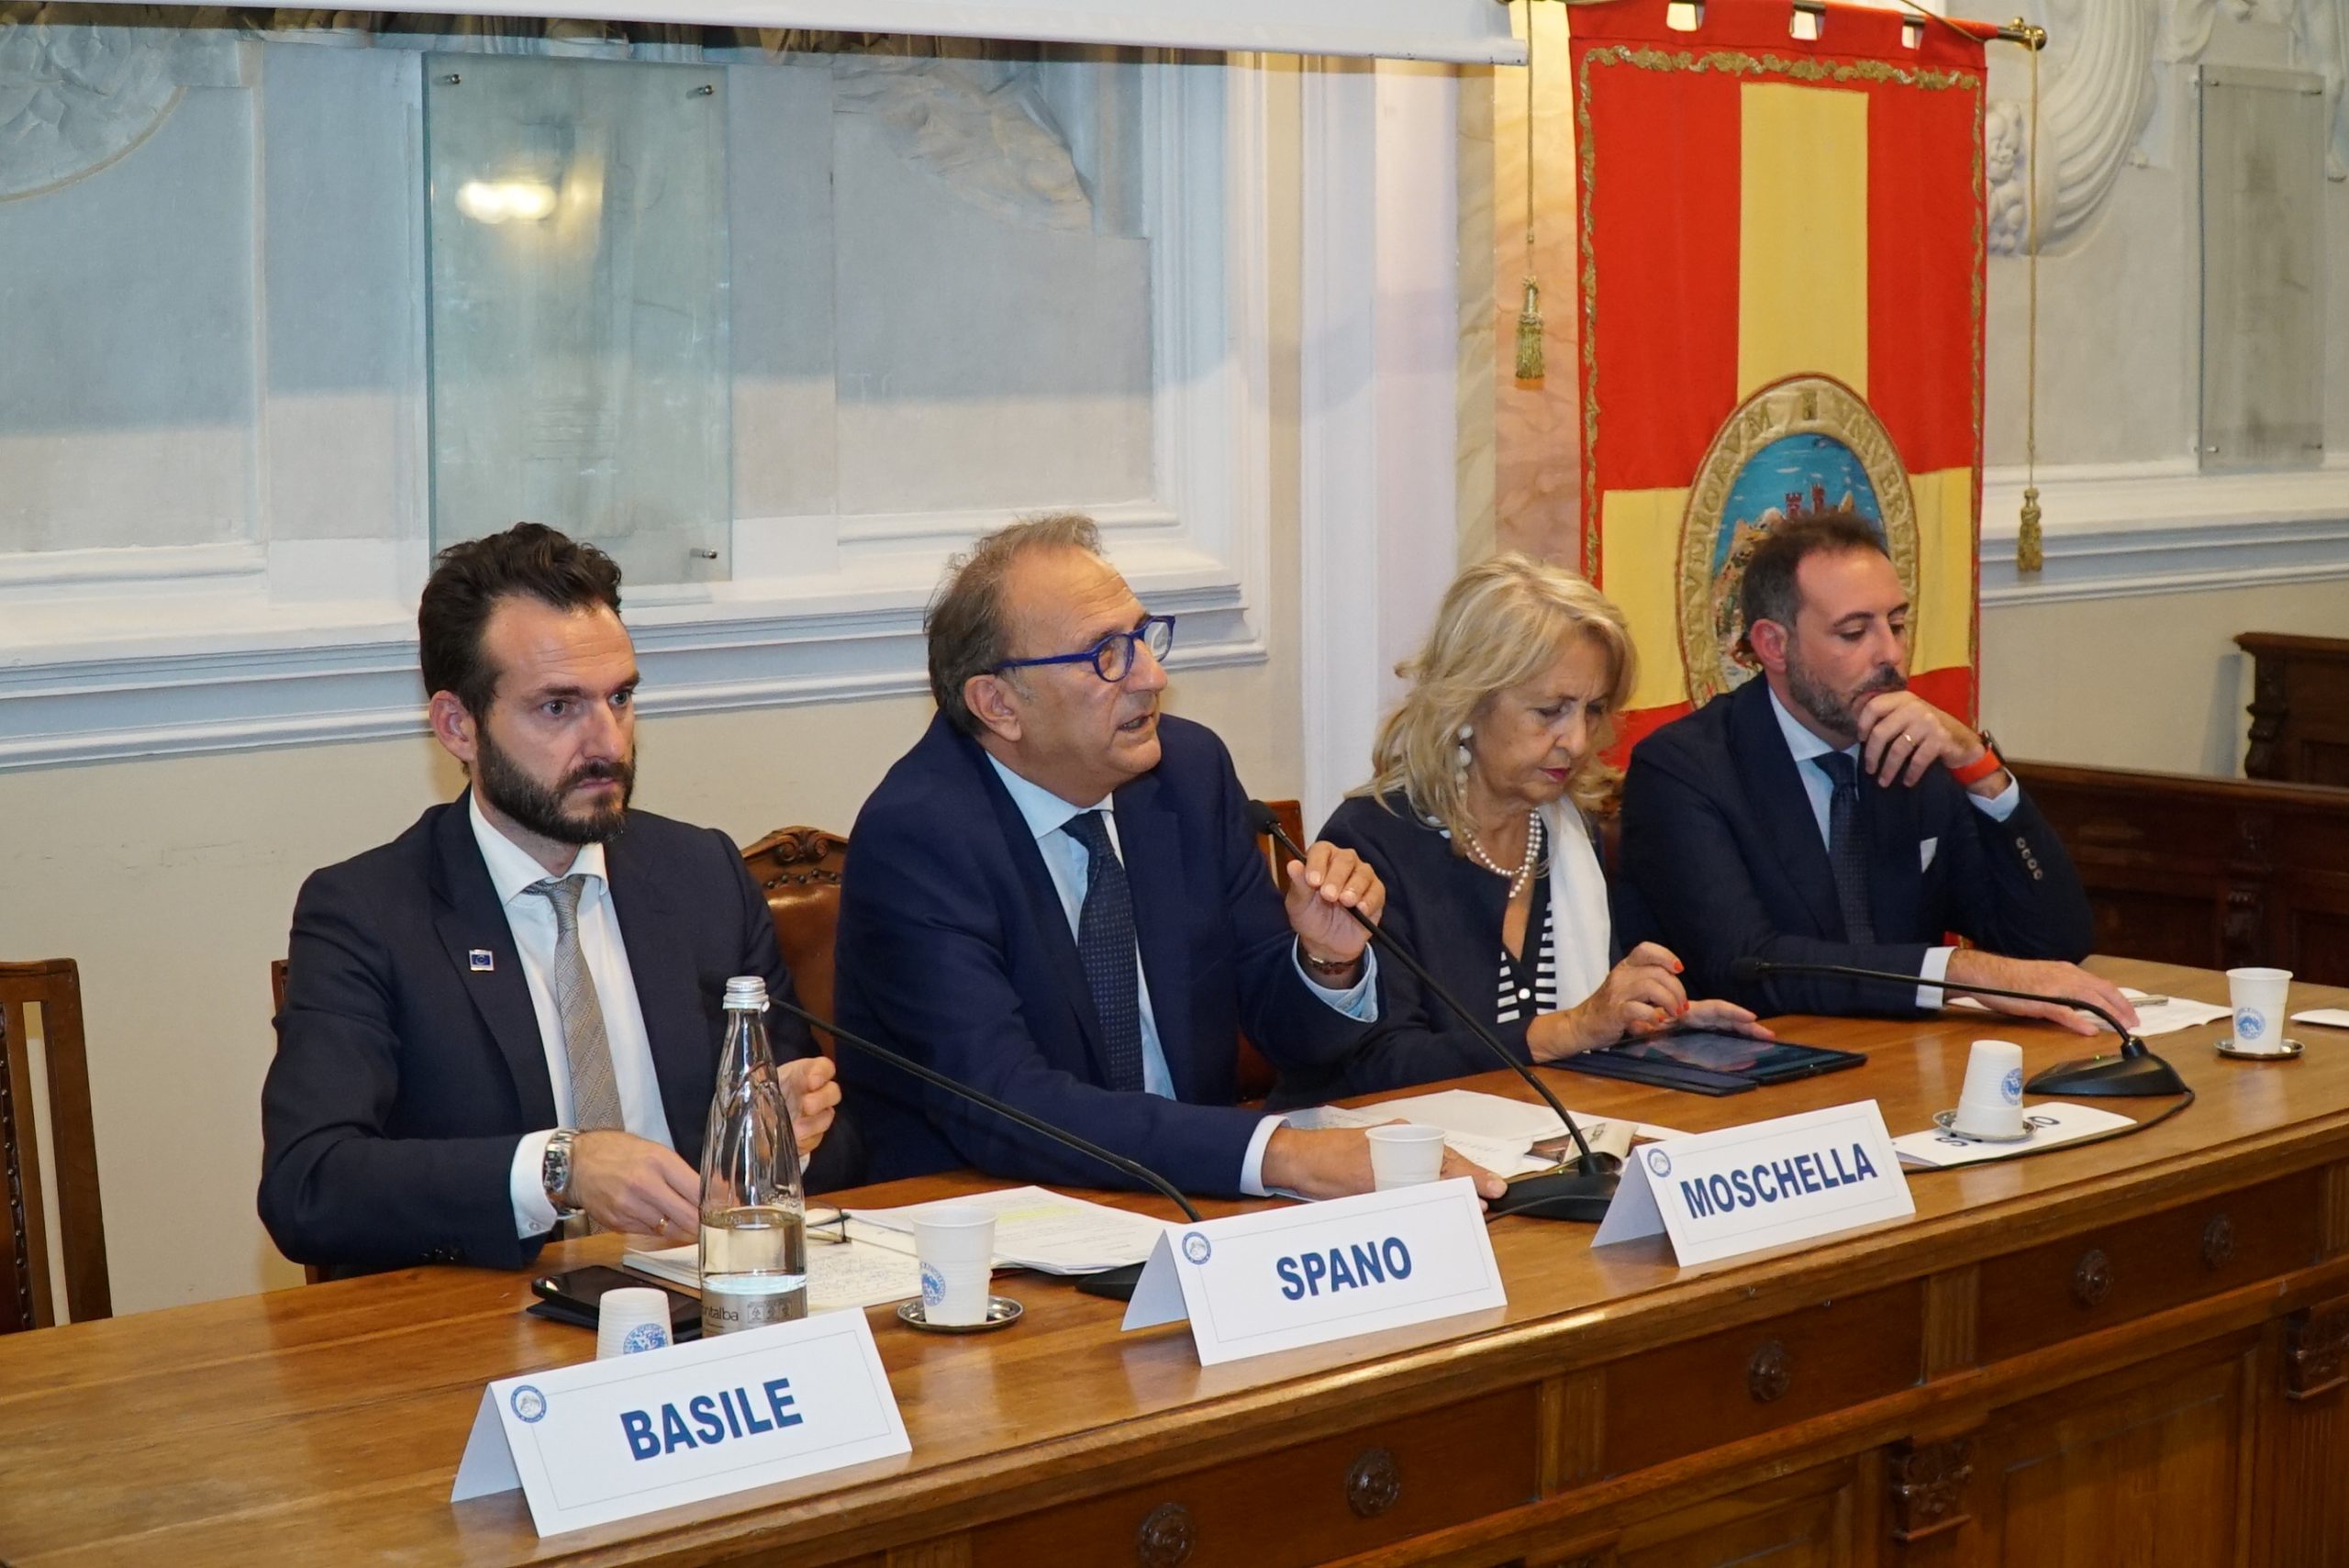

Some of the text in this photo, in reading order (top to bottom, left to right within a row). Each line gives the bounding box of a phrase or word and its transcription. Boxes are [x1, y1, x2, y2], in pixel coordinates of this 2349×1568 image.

[1680, 1143, 1878, 1218] MOSCHELLA
[1276, 1237, 1412, 1300] SPANO
[620, 1378, 804, 1461] BASILE
